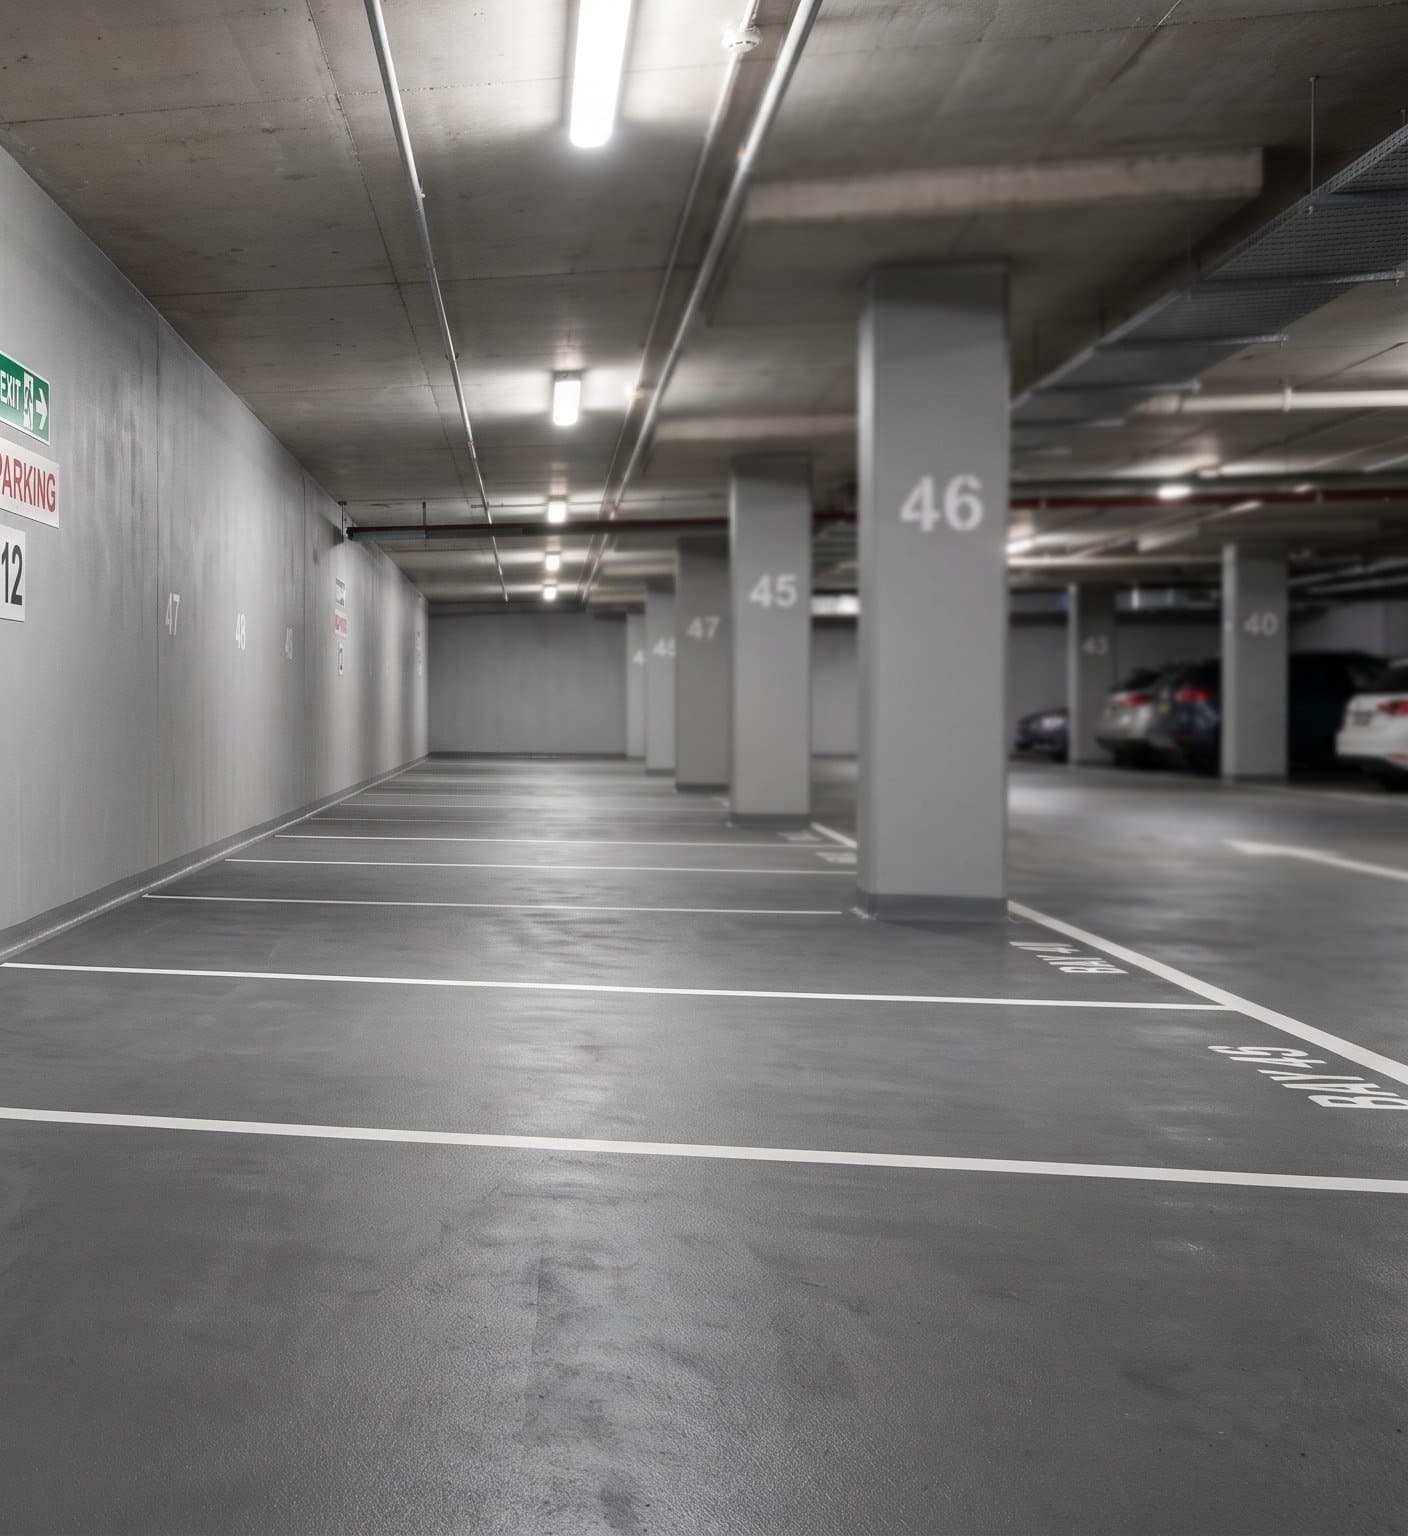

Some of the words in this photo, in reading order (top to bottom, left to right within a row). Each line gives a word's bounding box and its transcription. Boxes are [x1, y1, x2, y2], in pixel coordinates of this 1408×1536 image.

[0, 370, 22, 411] EXIT
[899, 474, 984, 533] 46
[1, 541, 23, 606] 12
[748, 572, 798, 609] 45
[165, 591, 180, 636] 47
[687, 615, 721, 641] 47
[1035, 954, 1129, 975] BAY
[1206, 1045, 1328, 1069] 45
[1255, 1068, 1408, 1111] BAY
